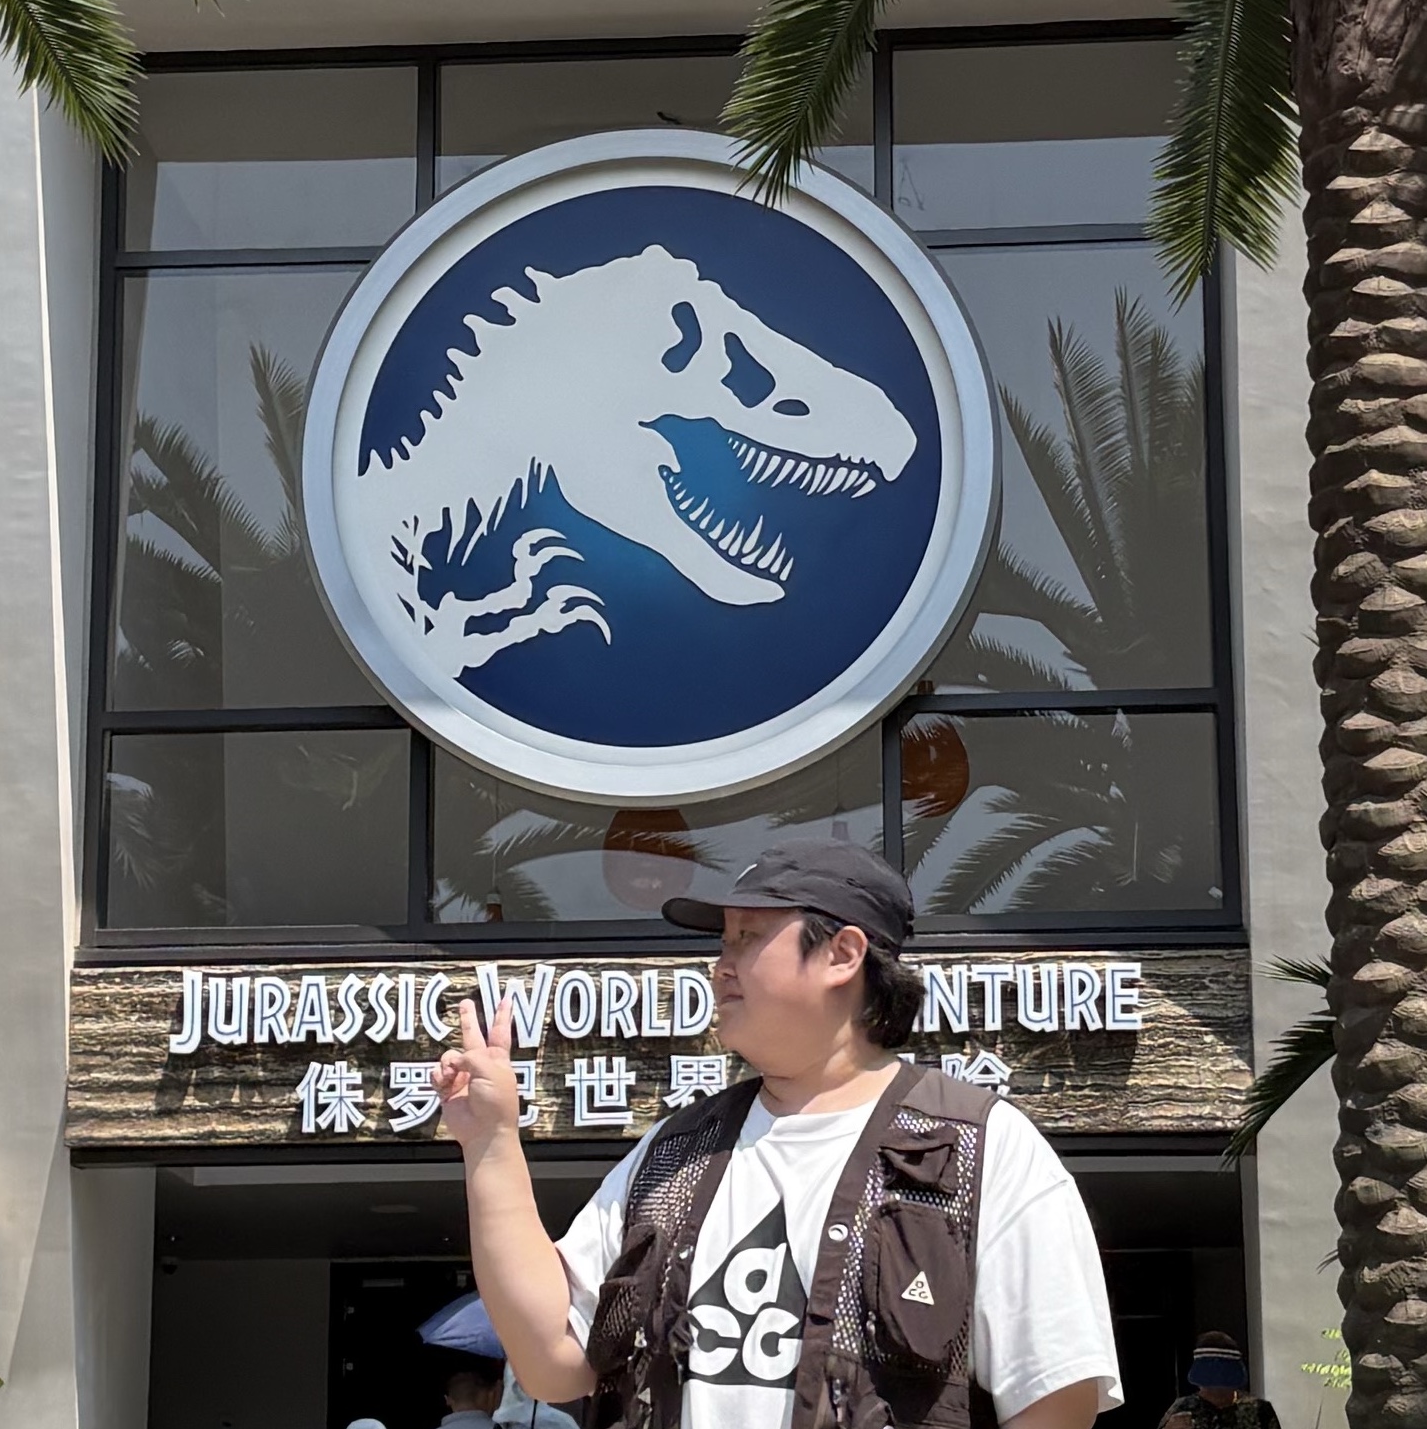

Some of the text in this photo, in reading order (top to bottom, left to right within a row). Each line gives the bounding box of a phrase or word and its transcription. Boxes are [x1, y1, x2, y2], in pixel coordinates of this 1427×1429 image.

[169, 962, 1143, 1055] JURASSIC WORLD NTURE
